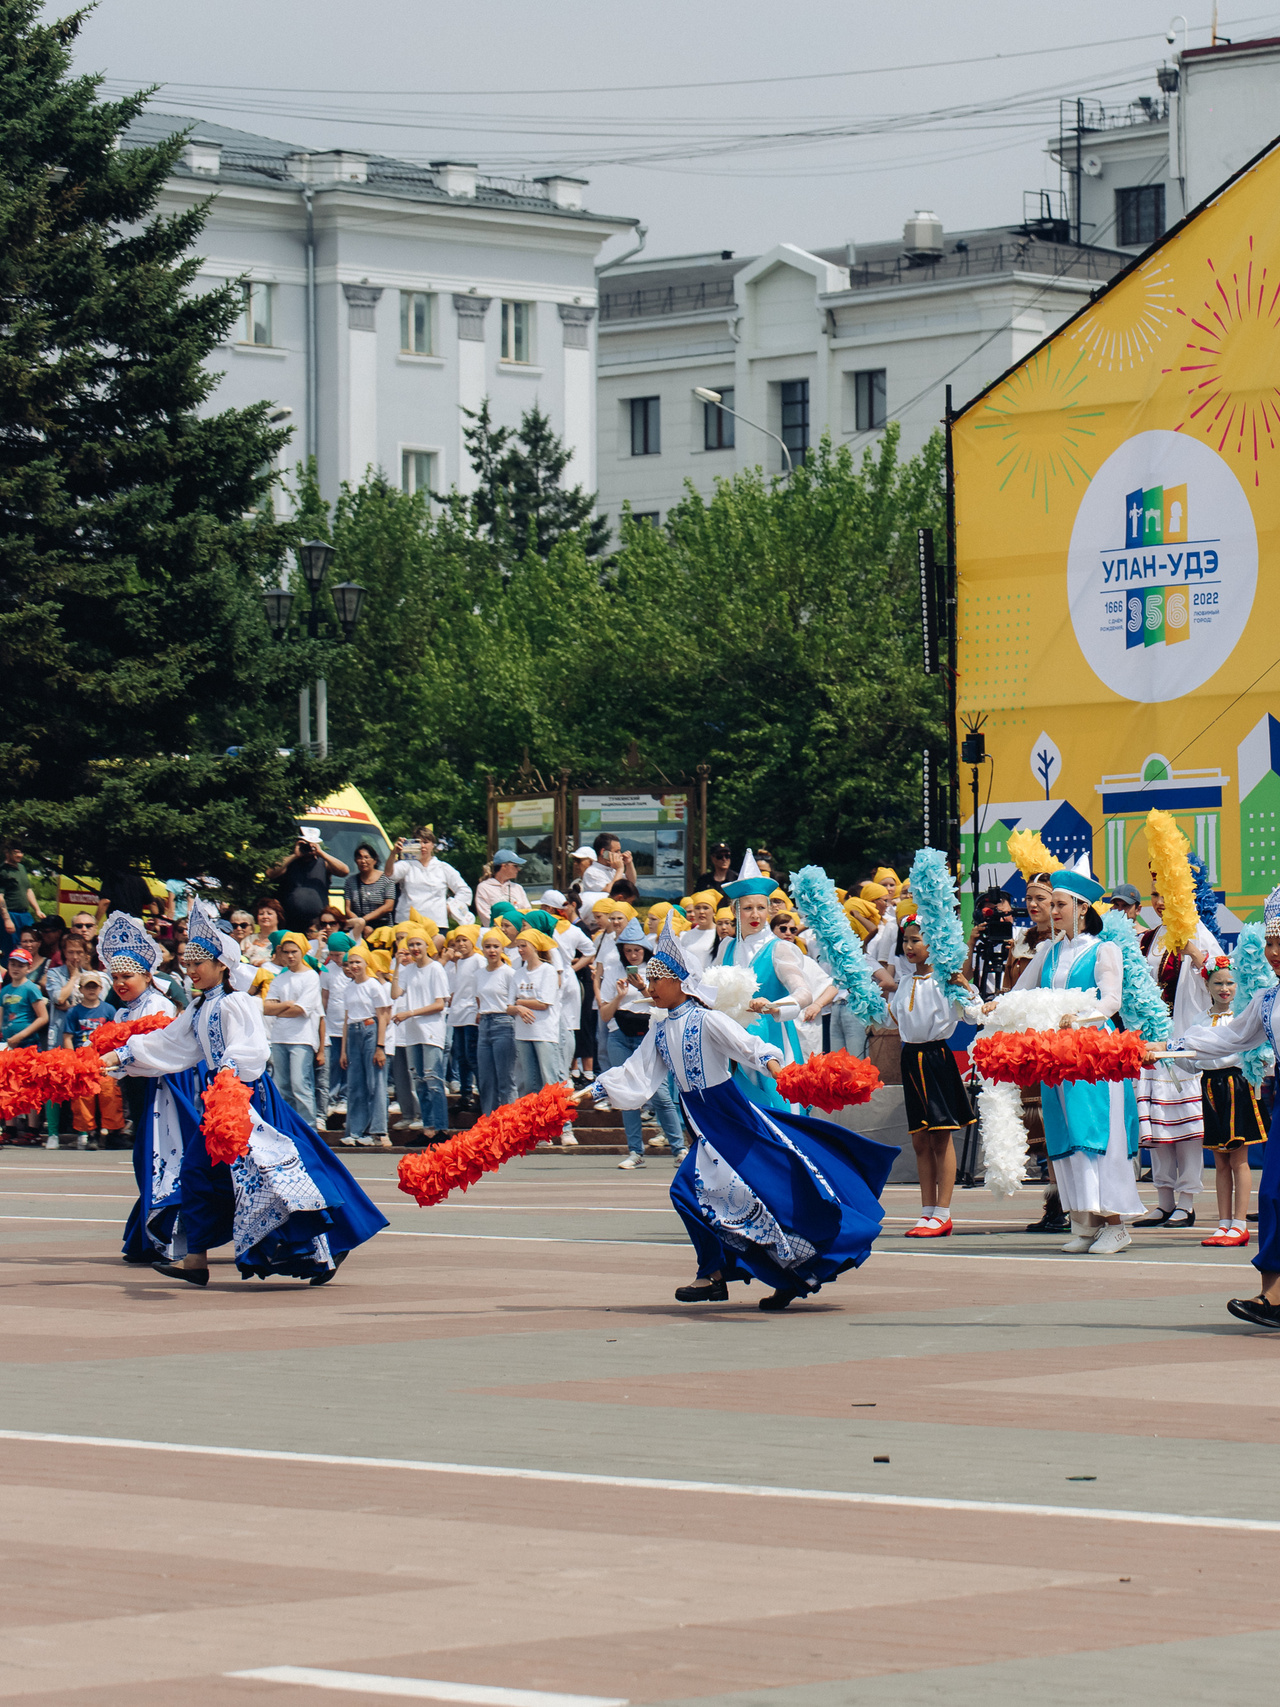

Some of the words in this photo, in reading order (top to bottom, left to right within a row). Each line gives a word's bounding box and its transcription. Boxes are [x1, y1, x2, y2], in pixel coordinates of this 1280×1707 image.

[1102, 550, 1218, 583] УЛАН-УДЭ
[1193, 592, 1219, 605] 2022
[1104, 600, 1123, 614] 1666
[1127, 593, 1188, 632] 356
[1114, 1230, 1127, 1242] LOVE
